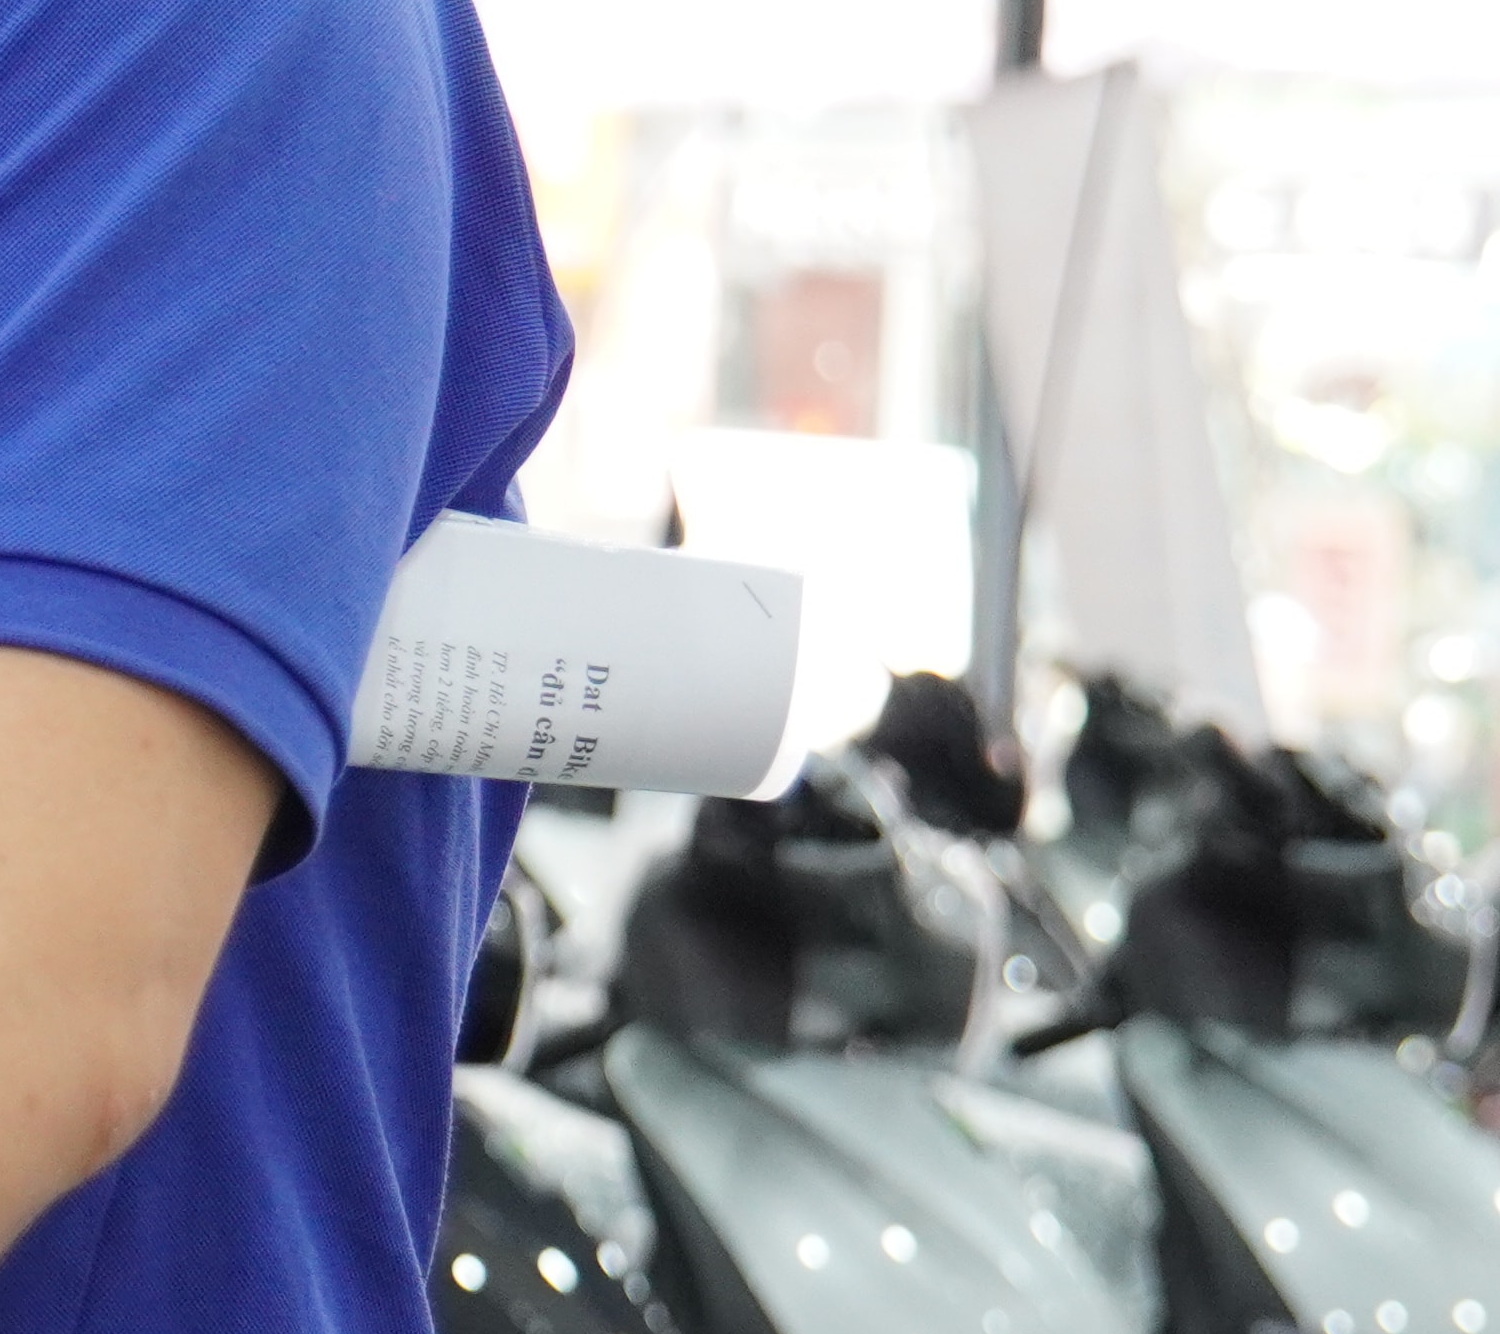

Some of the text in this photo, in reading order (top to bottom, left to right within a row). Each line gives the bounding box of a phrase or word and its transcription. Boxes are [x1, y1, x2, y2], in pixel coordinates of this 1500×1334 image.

[492, 651, 508, 674] TP.
[438, 676, 454, 687] 2
[582, 663, 610, 712] Dat
[382, 693, 398, 721] cho
[450, 730, 469, 761] toàn
[526, 717, 556, 759] cân
